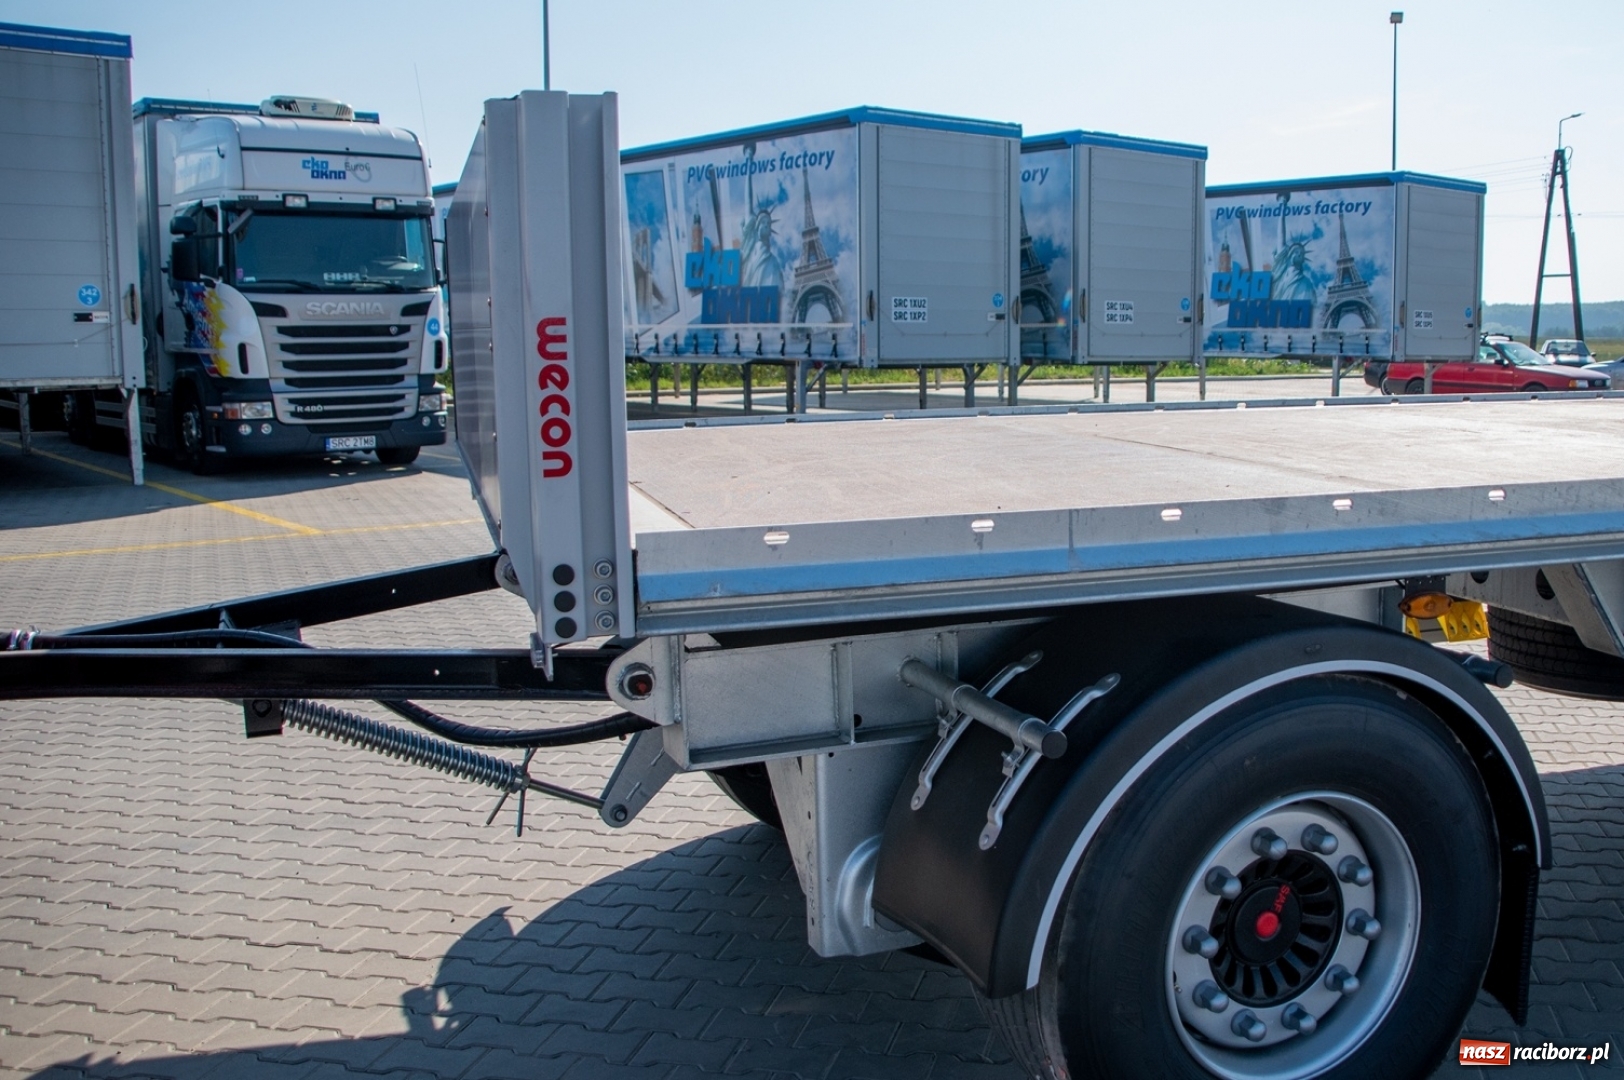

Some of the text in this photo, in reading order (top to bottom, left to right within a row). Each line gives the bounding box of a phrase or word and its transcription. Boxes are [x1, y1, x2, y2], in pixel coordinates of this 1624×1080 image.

[687, 150, 835, 184] PVC windows factory
[1020, 167, 1050, 186] ory
[1246, 203, 1311, 219] windows
[1314, 200, 1372, 216] factory
[893, 298, 908, 309] SRC
[1106, 302, 1118, 311] SRC
[306, 302, 385, 316] SCANIA
[893, 311, 927, 321] SRC 1XP2
[1106, 313, 1118, 322] SRC
[304, 404, 325, 413] 480
[331, 439, 351, 449] SRC
